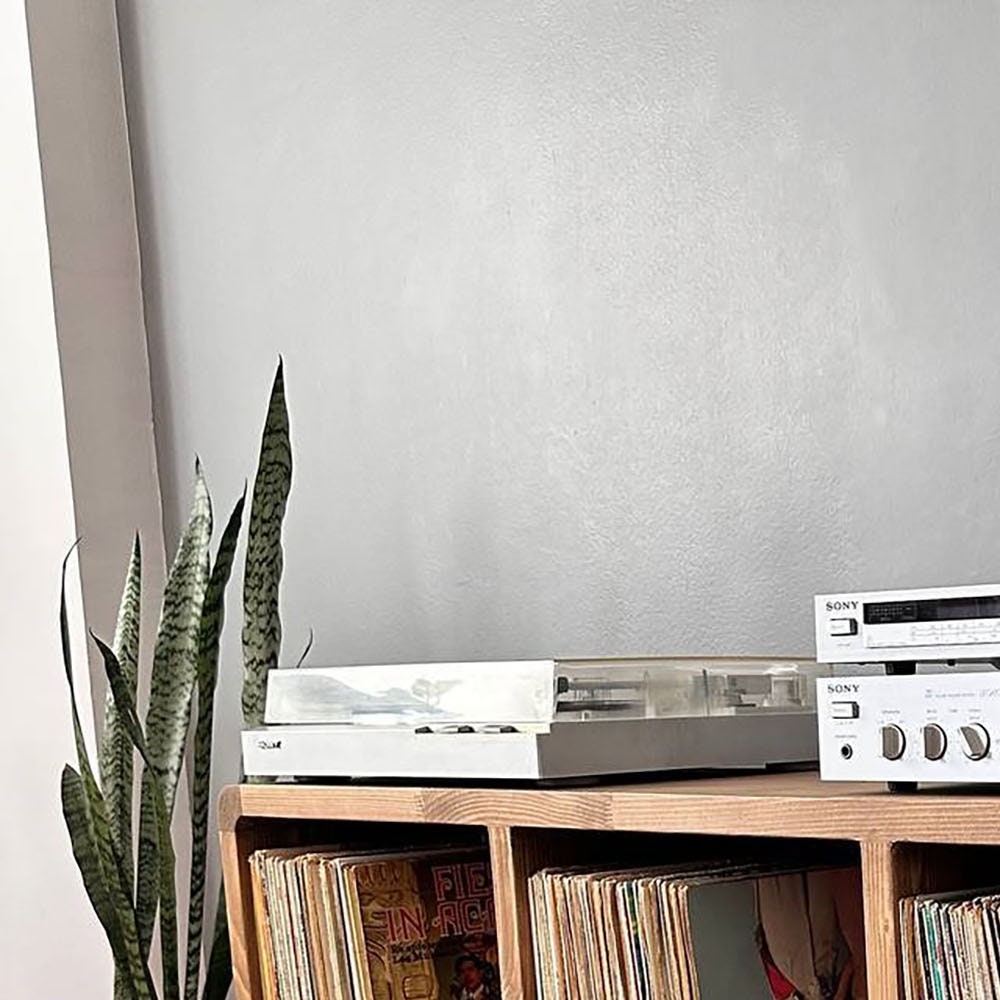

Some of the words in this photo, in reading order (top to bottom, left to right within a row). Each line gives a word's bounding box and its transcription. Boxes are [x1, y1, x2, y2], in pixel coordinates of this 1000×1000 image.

[825, 600, 859, 611] SONY
[827, 683, 861, 693] SONY
[386, 906, 427, 943] IN
